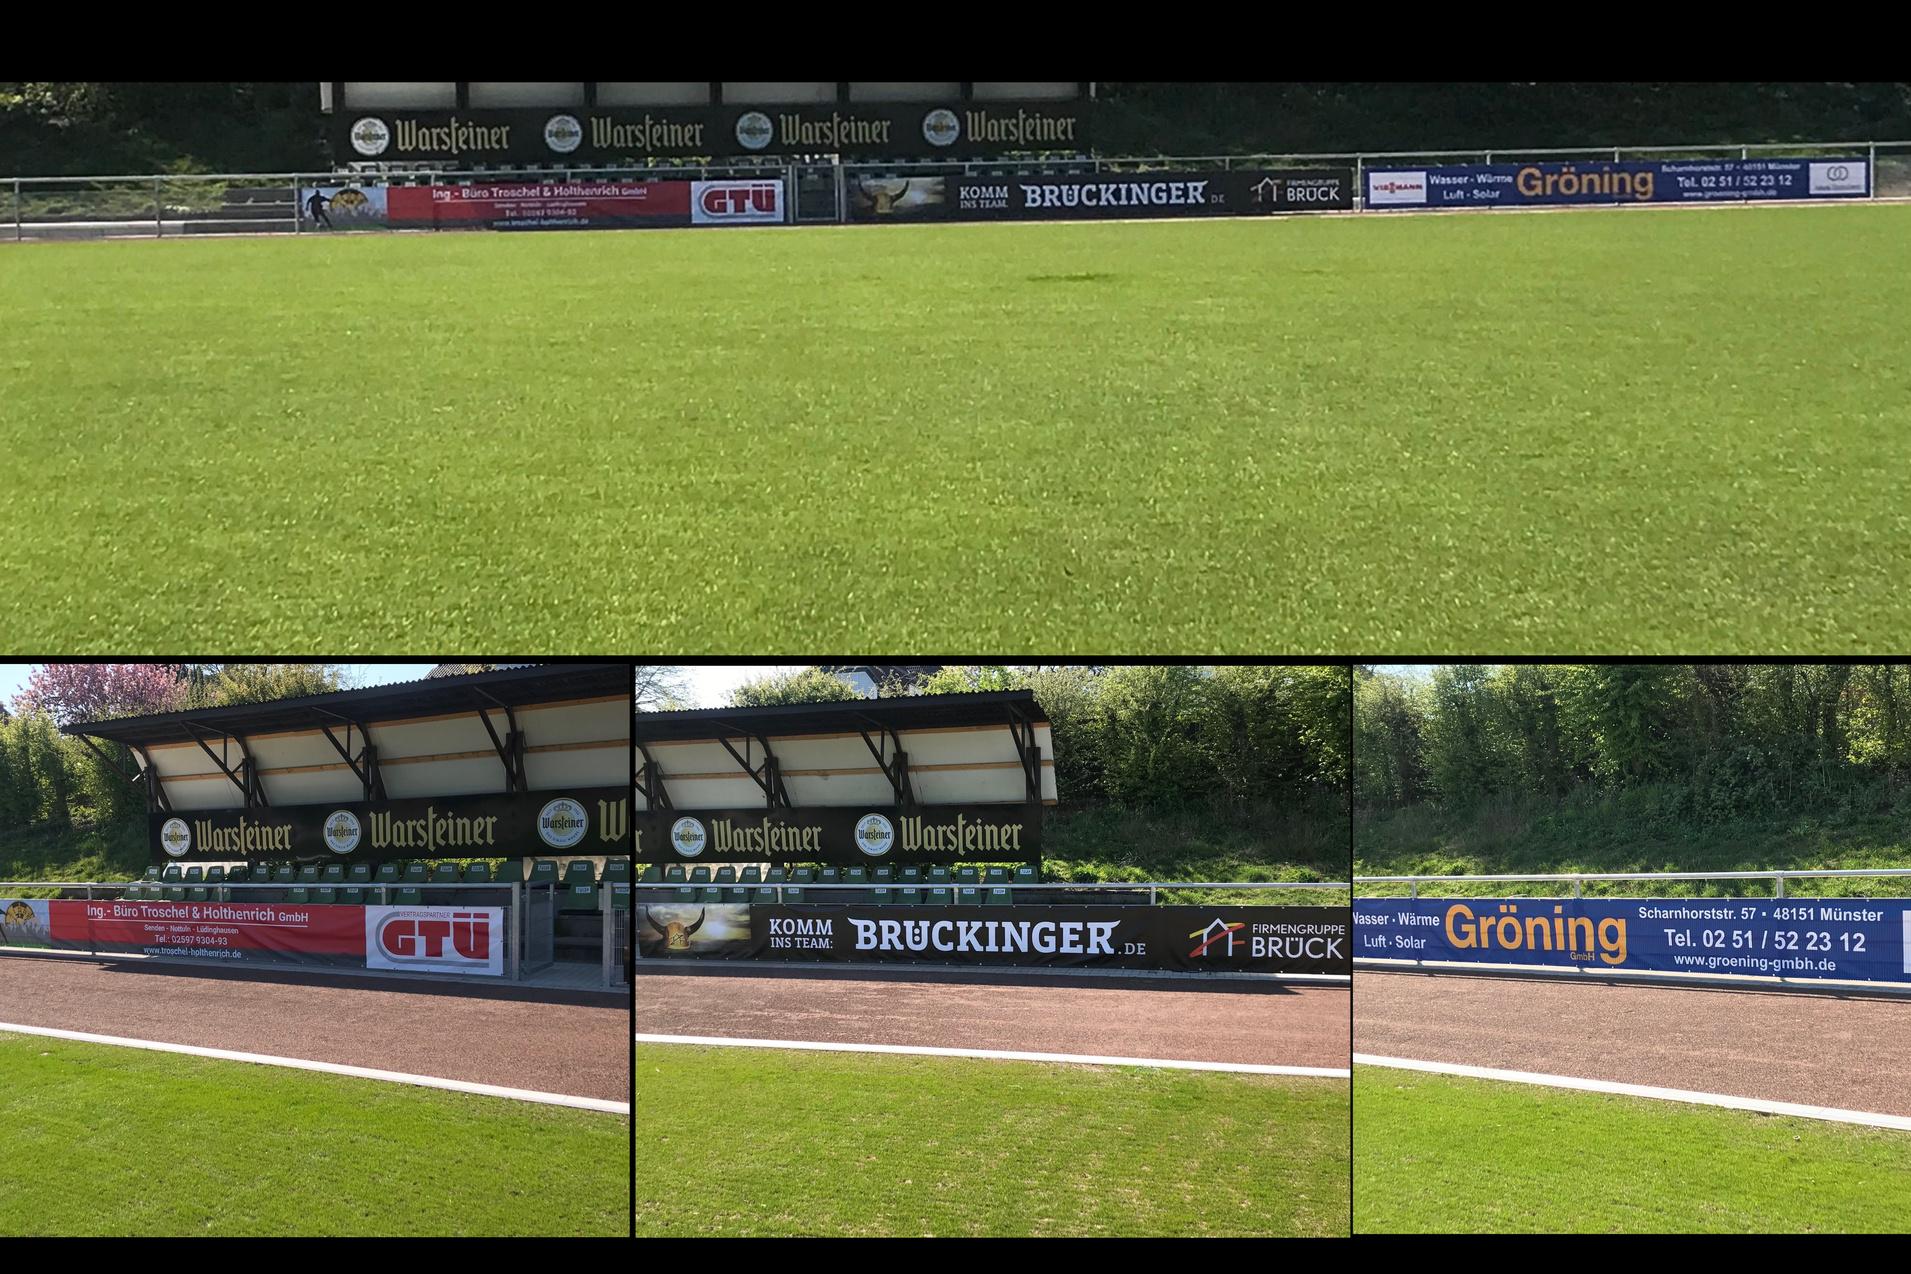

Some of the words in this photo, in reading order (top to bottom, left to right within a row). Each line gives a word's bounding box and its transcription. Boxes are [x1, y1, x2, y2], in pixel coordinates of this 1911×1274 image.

[395, 116, 510, 154] Warsteiner
[590, 114, 704, 150] Warsteiner
[779, 112, 891, 148] Warsteiner
[966, 108, 1076, 145] Warsteiner
[1429, 174, 1469, 185] Wasser
[1476, 173, 1514, 184] Wärme
[1516, 165, 1654, 201] Gröning
[1677, 177, 1698, 189] Tel.
[1701, 176, 1716, 188] 02
[1719, 175, 1733, 187] 51
[1743, 175, 1758, 187] 52
[1760, 174, 1775, 187] 23
[1779, 174, 1792, 186] 12
[462, 188, 488, 199] Büro
[491, 187, 540, 198] Troschel
[554, 186, 619, 197] Holthenrich
[702, 183, 776, 214] GTÜ
[960, 186, 1009, 200] KOMM
[1286, 187, 1340, 202] BRÜCK
[1443, 190, 1465, 200] Luft
[1473, 189, 1500, 199] Solar
[960, 200, 977, 208] INS
[368, 806, 498, 853] Warsteiner
[542, 816, 585, 831] Warsteiner
[195, 815, 292, 855] Warsteiner
[712, 817, 822, 857] Warsteiner
[858, 828, 891, 841] Warsteiner
[899, 814, 1024, 857] Warsteiner
[114, 904, 138, 918] Büro
[140, 905, 189, 920] Troschel
[192, 907, 200, 919] &
[203, 907, 275, 923] Holthenrich
[278, 912, 308, 924] GmbH
[400, 911, 451, 919] VERTRAGSPARTNER
[1398, 912, 1440, 928] Wärme
[1638, 906, 1737, 921] Scharnhorststr.
[1741, 907, 1756, 921] 57
[1773, 907, 1815, 922] 48151
[1820, 908, 1884, 924] Münster
[144, 923, 165, 933] Senden
[196, 925, 239, 937] Lüdinghausen
[769, 919, 833, 936] KOMM
[1251, 924, 1345, 937] FIRMENGRUPPE
[1445, 903, 1627, 965] Gröning
[172, 935, 194, 946] 02597
[196, 936, 227, 947] 9304-93
[382, 912, 490, 961] GTÜ
[770, 938, 792, 950] INS
[795, 938, 833, 951] TEAM:
[1364, 934, 1387, 949] Luft
[1395, 935, 1427, 951] Solar
[1664, 928, 1696, 948] Tel.
[1703, 929, 1726, 949] 02
[1733, 930, 1754, 950] 51
[1774, 931, 1799, 951] 52
[1806, 932, 1831, 952] 23
[1840, 933, 1866, 953] 12
[144, 946, 242, 960] www.troschel-holthenrich.de
[1251, 937, 1344, 961] BRÜCK
[1570, 951, 1595, 962] GmbH
[1673, 954, 1837, 973] www.groening-gmbh.de
